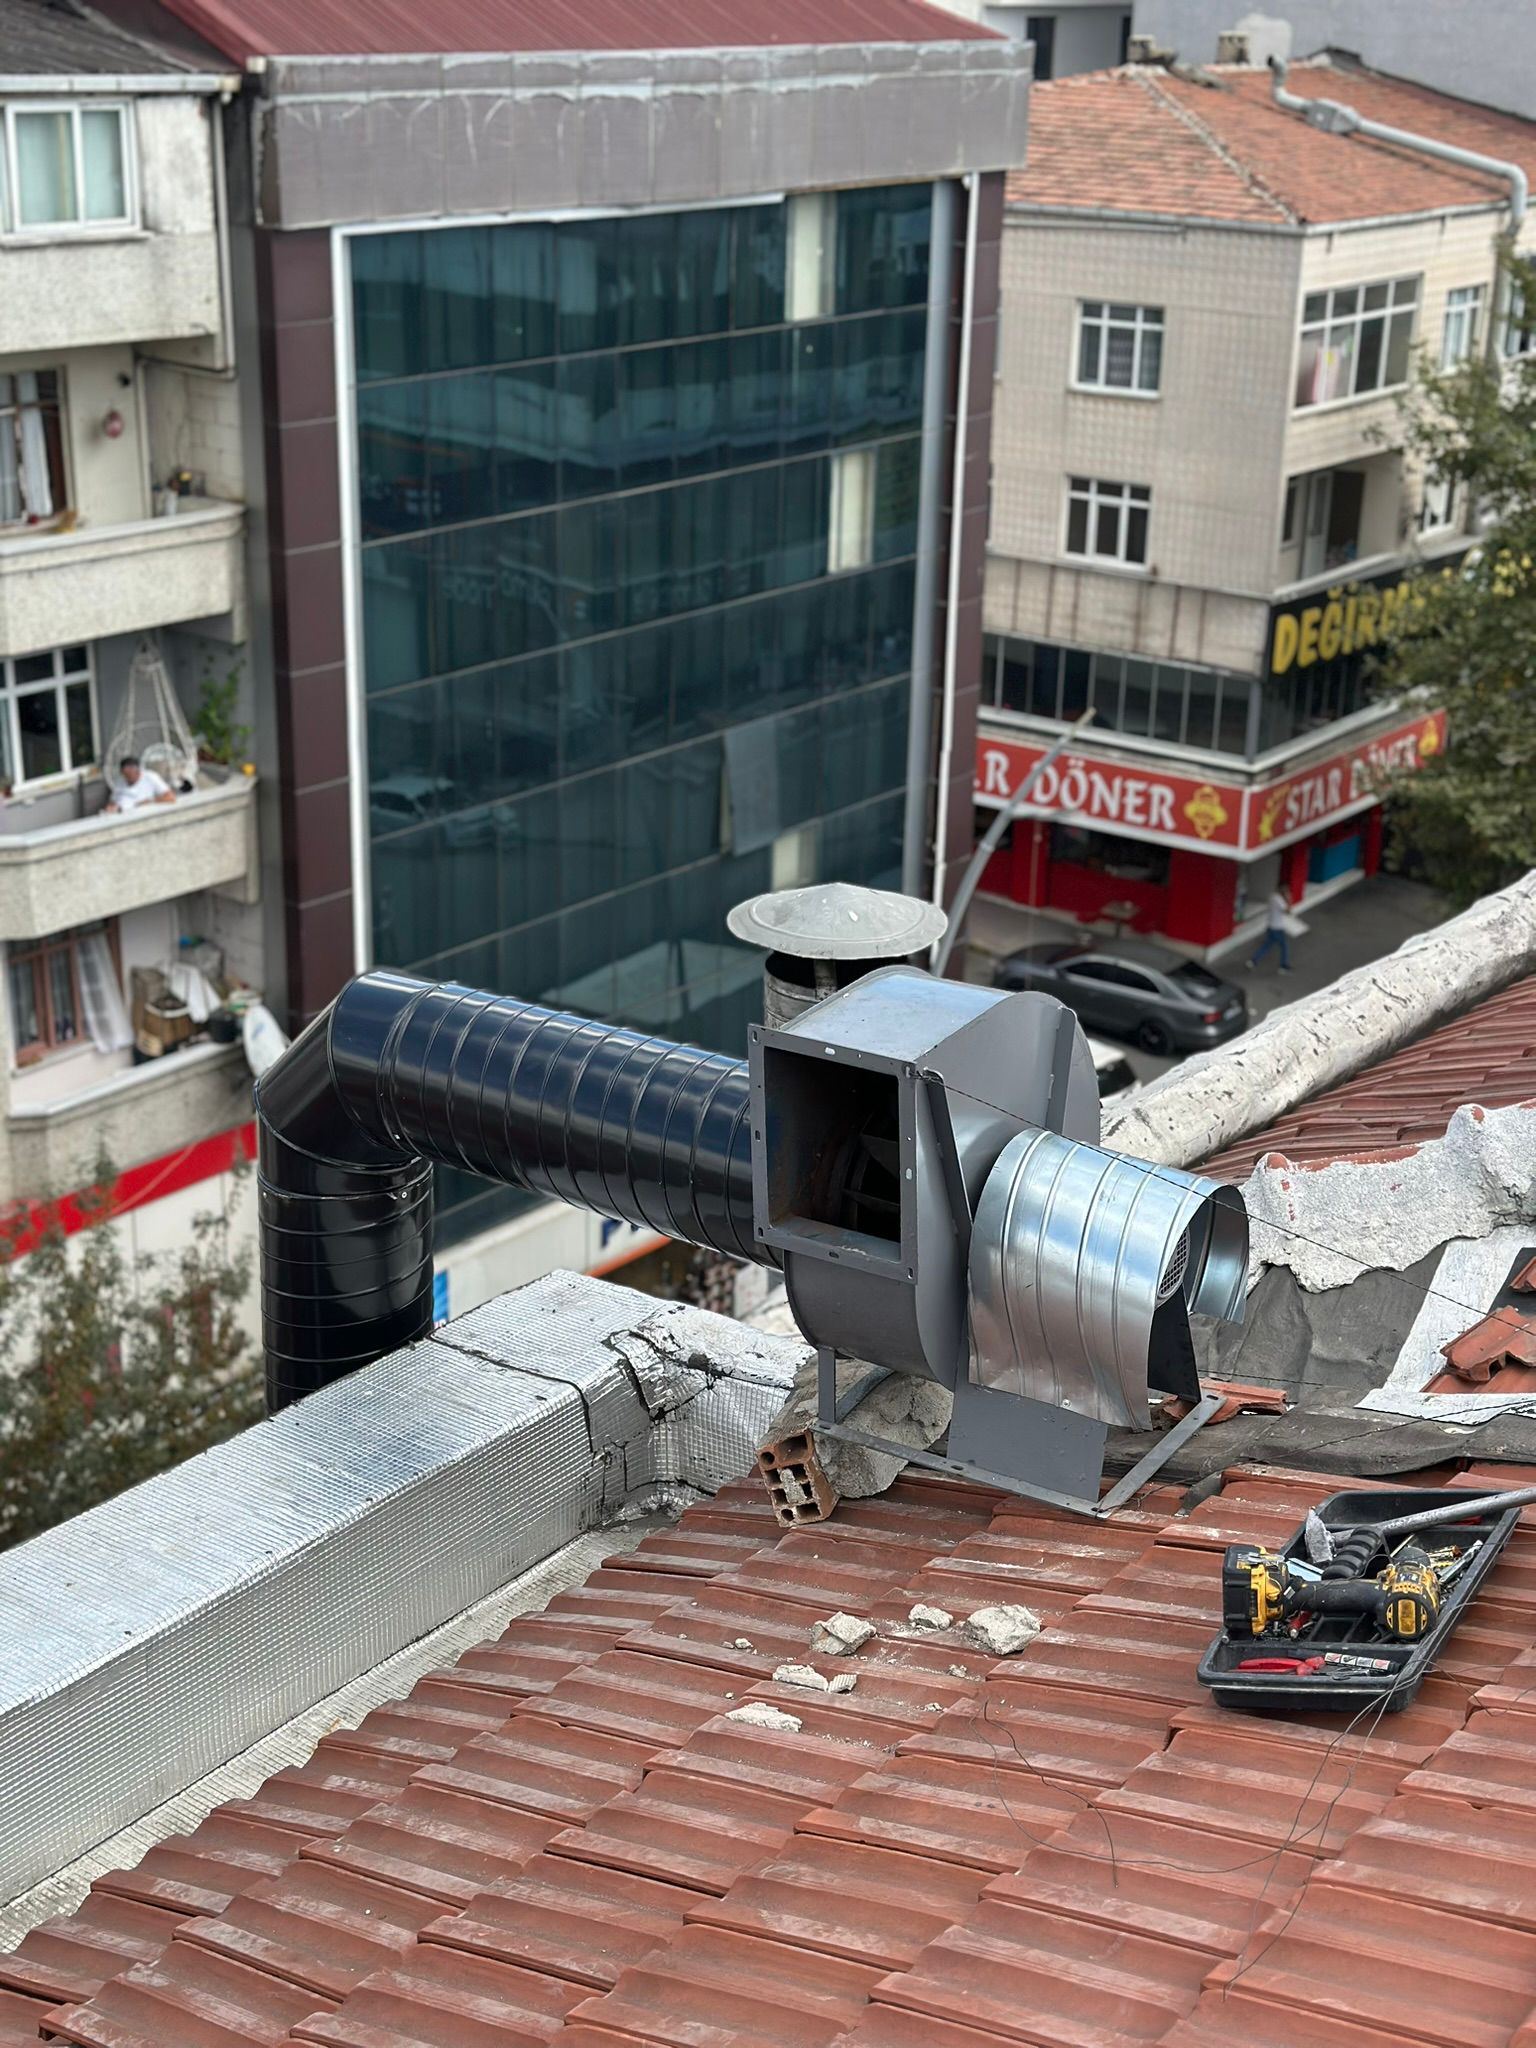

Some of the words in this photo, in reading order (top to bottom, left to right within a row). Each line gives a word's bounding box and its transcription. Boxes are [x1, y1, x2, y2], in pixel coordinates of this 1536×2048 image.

[974, 750, 1011, 796] R
[1031, 757, 1176, 831] DÖNER
[1284, 767, 1342, 831] STAR
